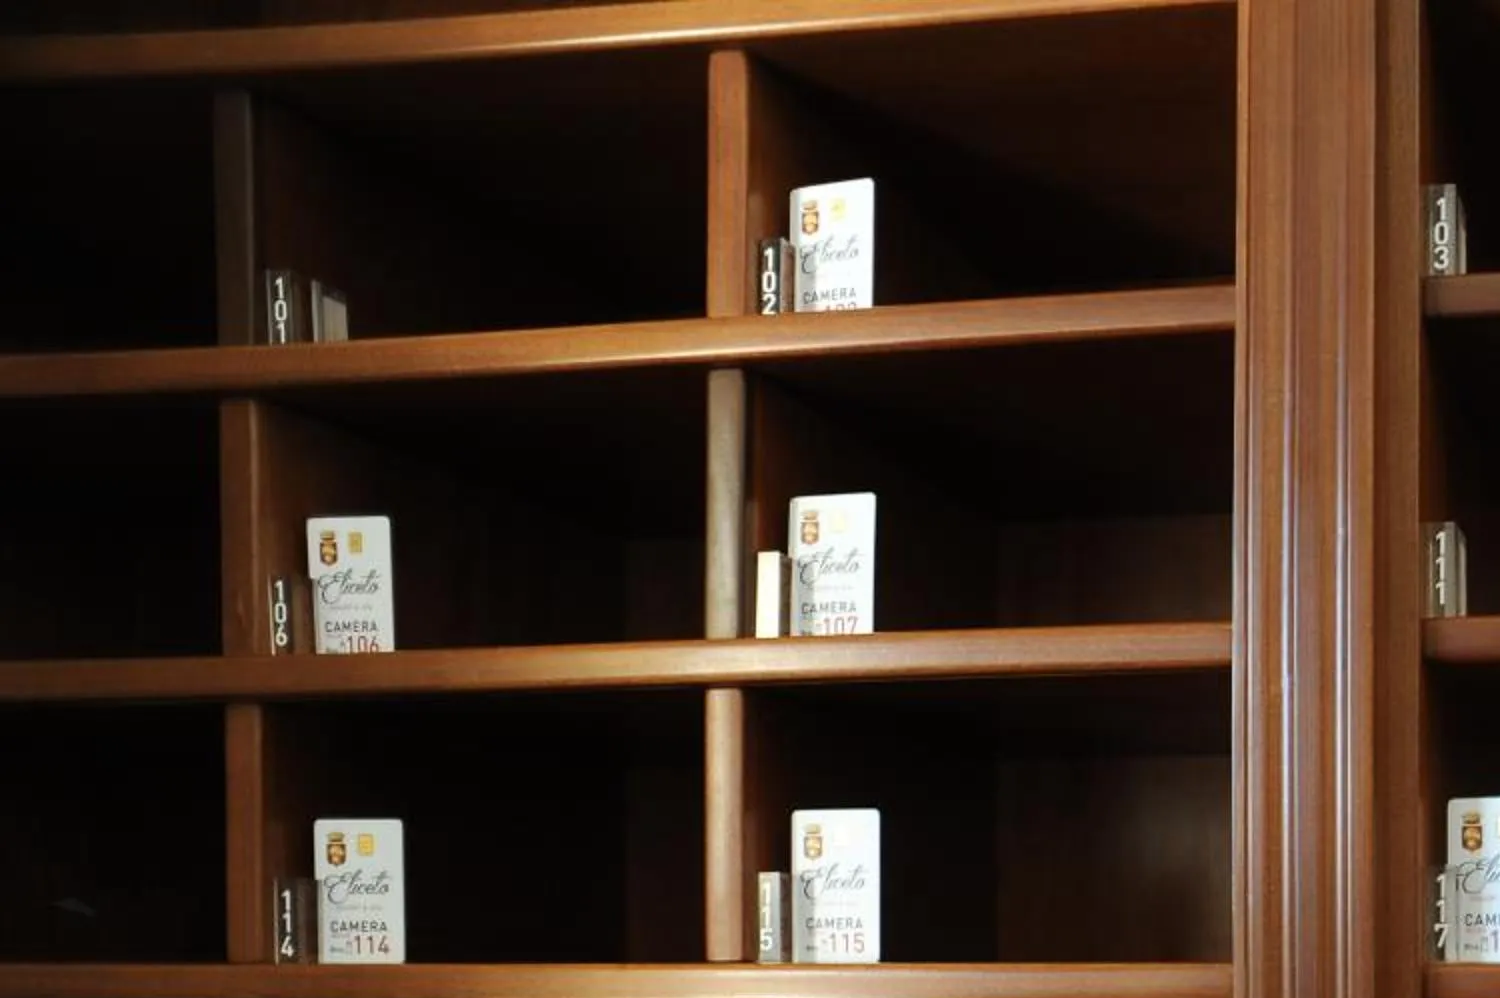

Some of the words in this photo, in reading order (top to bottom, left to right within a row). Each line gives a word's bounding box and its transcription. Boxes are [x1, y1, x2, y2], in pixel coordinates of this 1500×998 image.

[1433, 197, 1449, 269] 103
[762, 247, 778, 315] 102
[803, 287, 858, 304] CAMERA
[275, 276, 288, 345] 101
[1435, 531, 1446, 605] 111
[274, 579, 288, 646] 106
[802, 601, 857, 614] CAMERA
[325, 621, 378, 633] CAMERA
[823, 616, 859, 635] 107
[346, 635, 380, 652] 106
[1434, 873, 1449, 948] 117
[281, 889, 294, 957] 114
[331, 920, 388, 933] CAMERA
[806, 918, 863, 931] CAMERA
[353, 936, 390, 955] 114
[829, 933, 866, 954] 115
